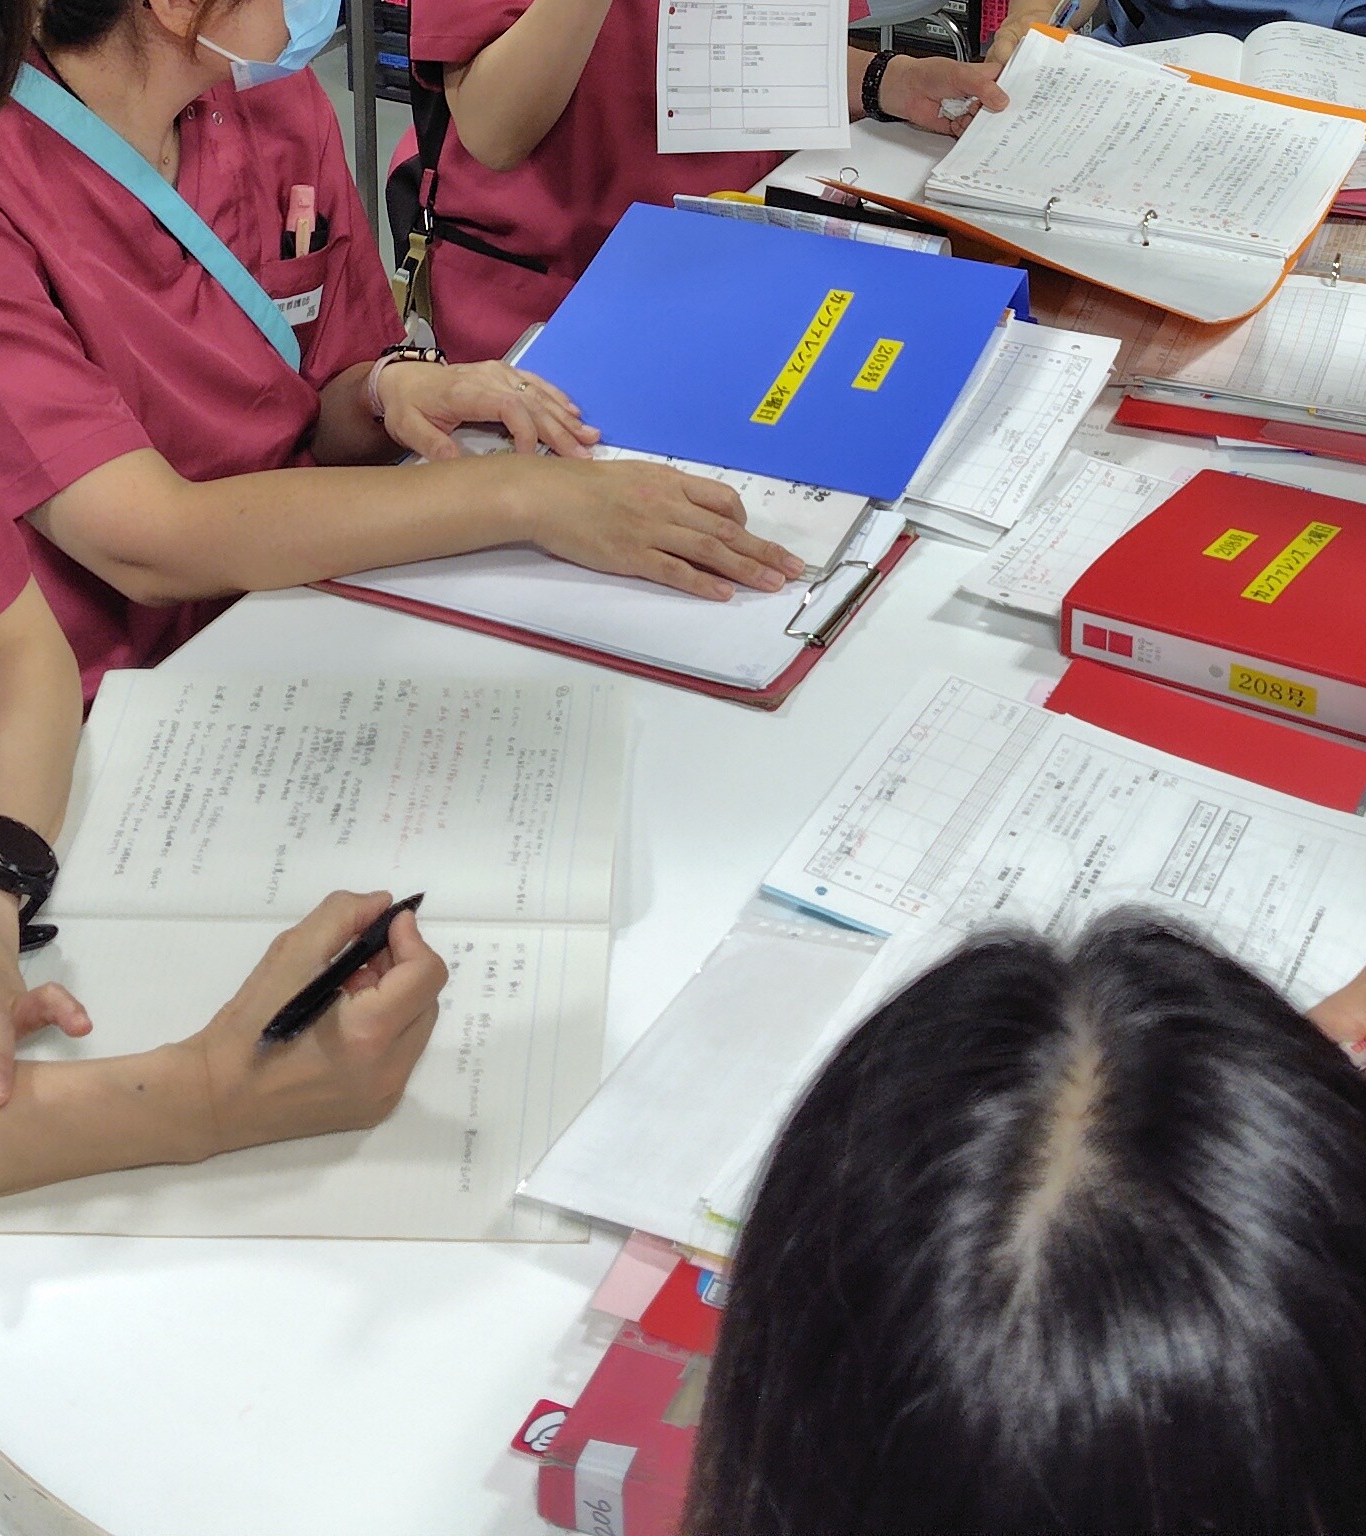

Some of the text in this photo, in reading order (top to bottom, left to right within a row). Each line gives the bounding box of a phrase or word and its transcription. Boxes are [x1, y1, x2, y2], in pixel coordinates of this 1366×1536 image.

[754, 291, 849, 422] カンファレンス 火曜日
[859, 343, 900, 388] 203号
[1214, 530, 1254, 558] 208号
[1249, 522, 1338, 601] カンファレンス 火曜日
[1236, 671, 1307, 710] 208号
